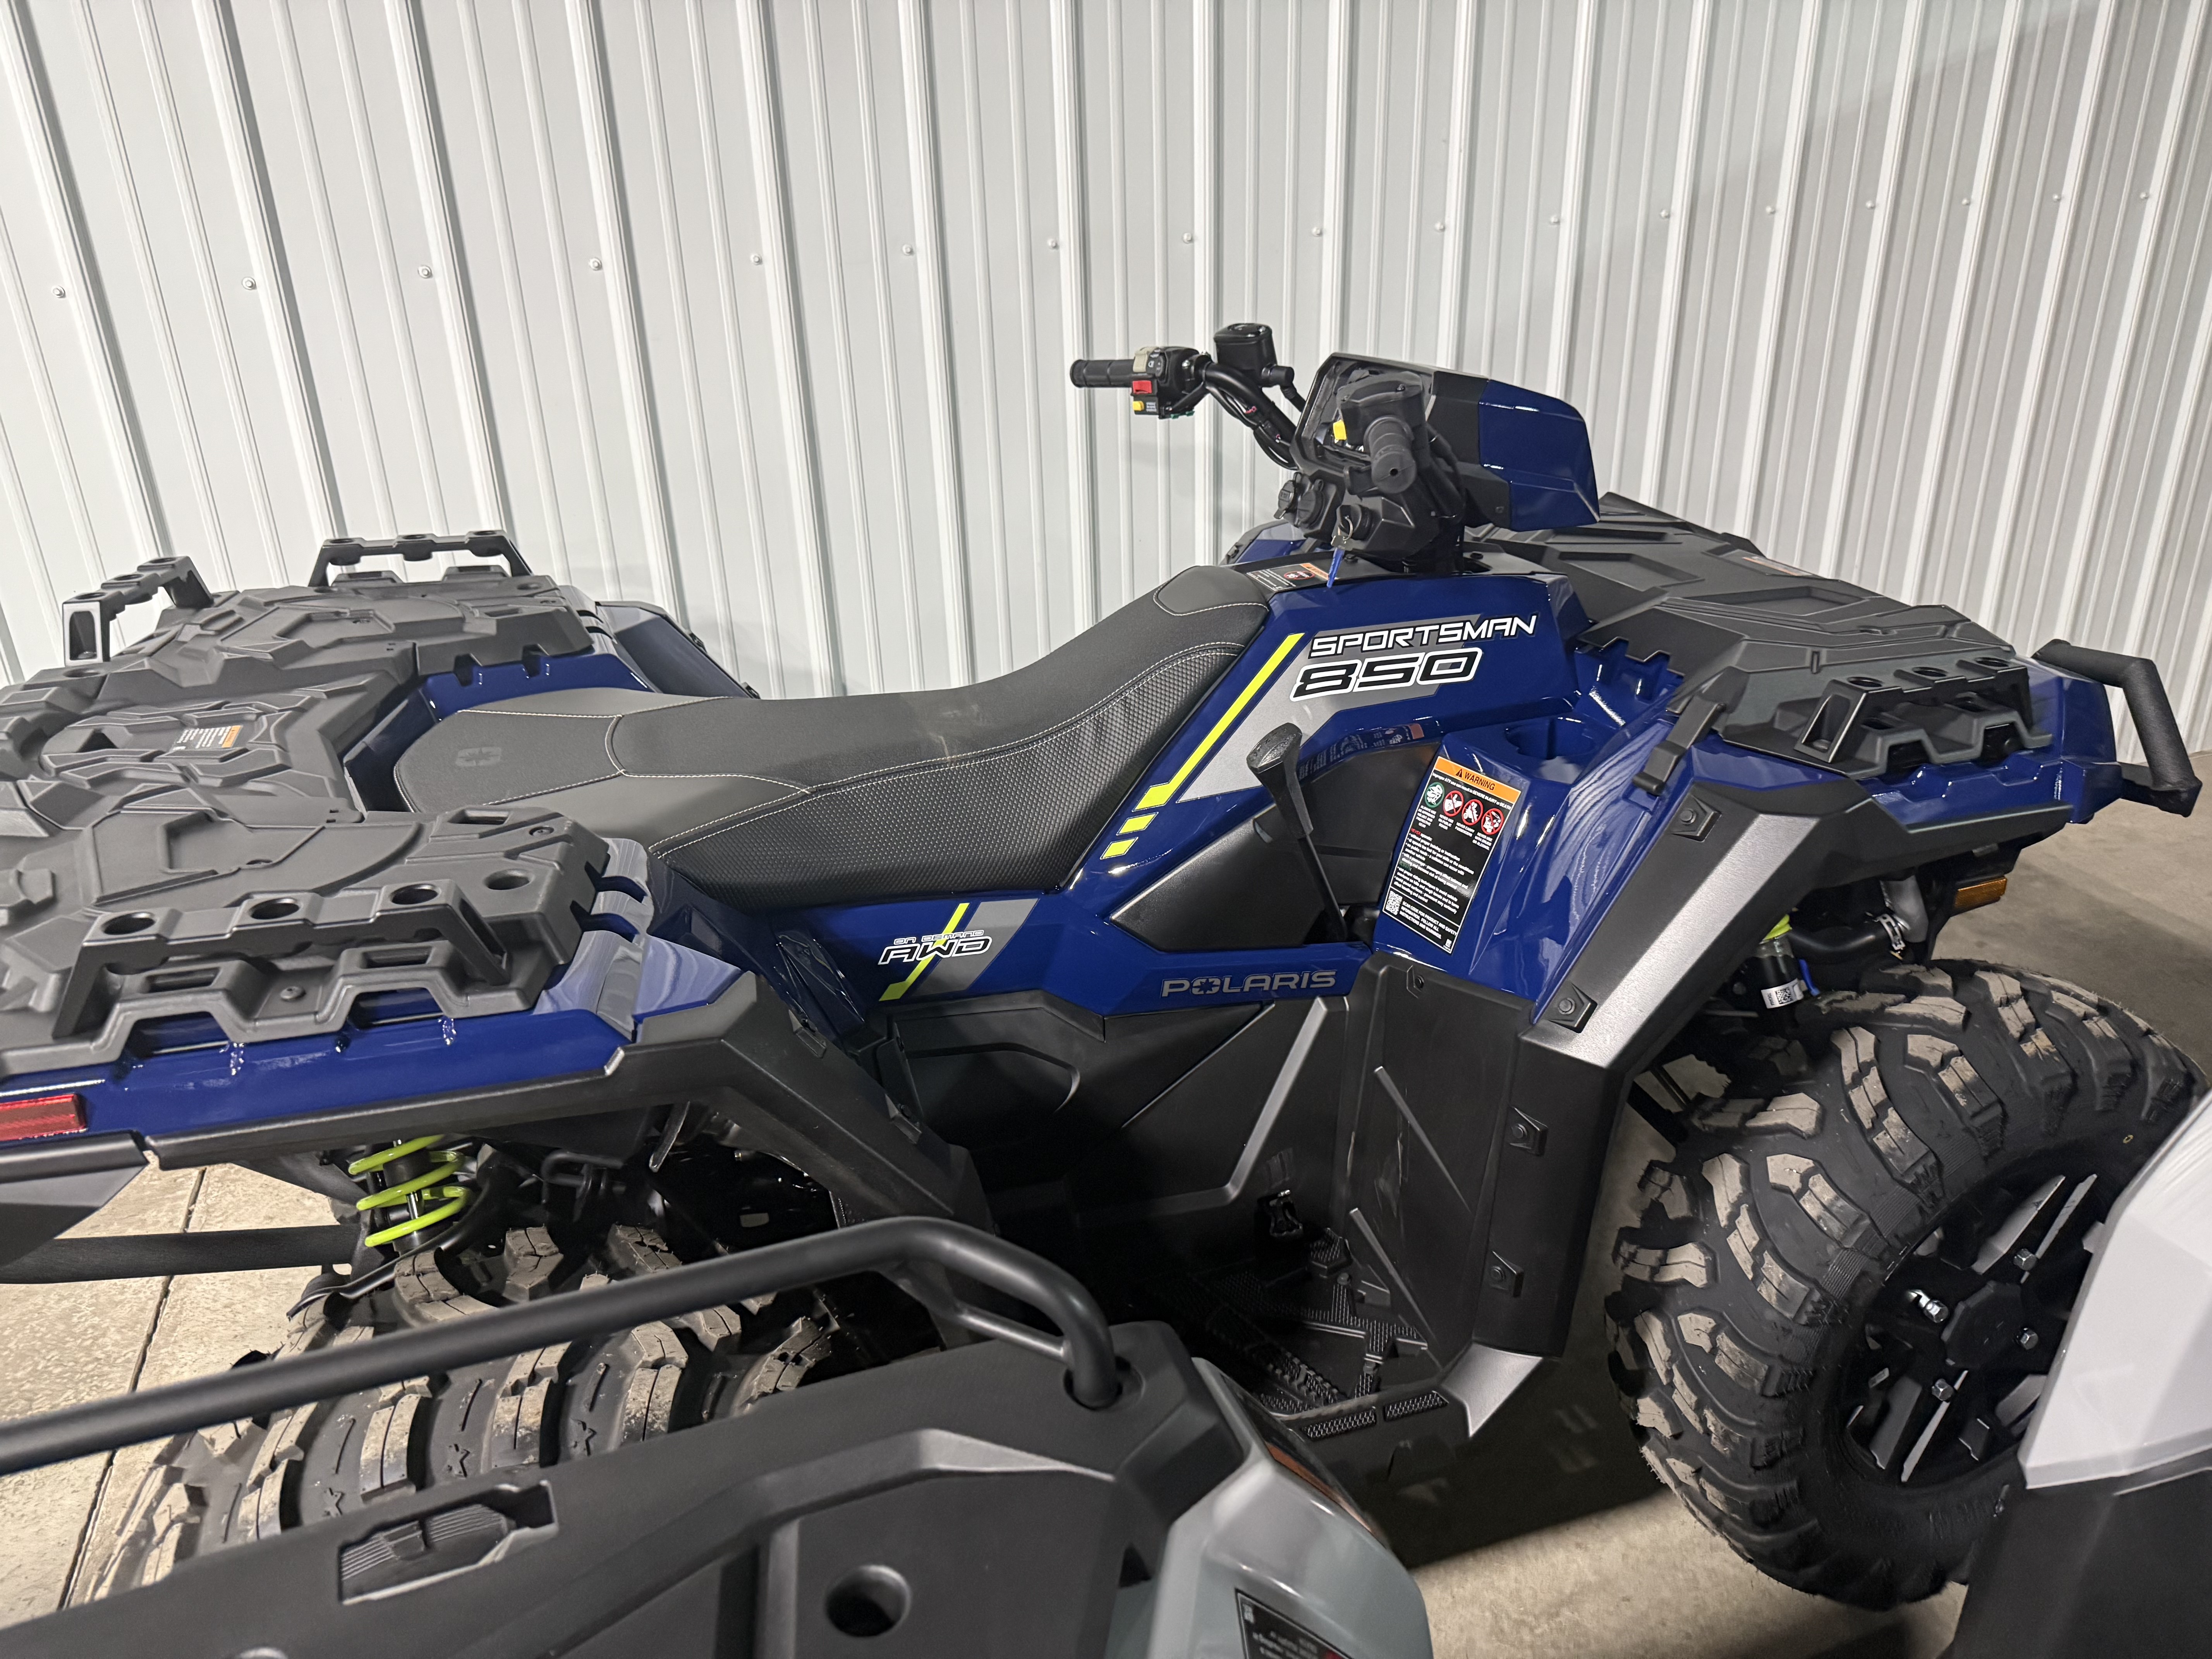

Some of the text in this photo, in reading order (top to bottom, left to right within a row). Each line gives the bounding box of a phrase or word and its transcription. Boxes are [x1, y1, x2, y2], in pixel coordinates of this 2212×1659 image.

[1310, 615, 1537, 657] SPORTSMAN
[1290, 647, 1482, 702] 850
[1465, 771, 1495, 790] WARNING
[1472, 790, 1486, 799] SEVERE
[1484, 795, 1497, 804] INJURY
[1410, 905, 1419, 914] CODE
[1424, 914, 1439, 925] PRODUCT
[1445, 926, 1457, 936] SAFETY
[1420, 917, 1434, 928] FOLLOW
[878, 935, 993, 965] AWD
[893, 929, 984, 945] ON DEMAND
[1162, 970, 1336, 997] POLARIS
